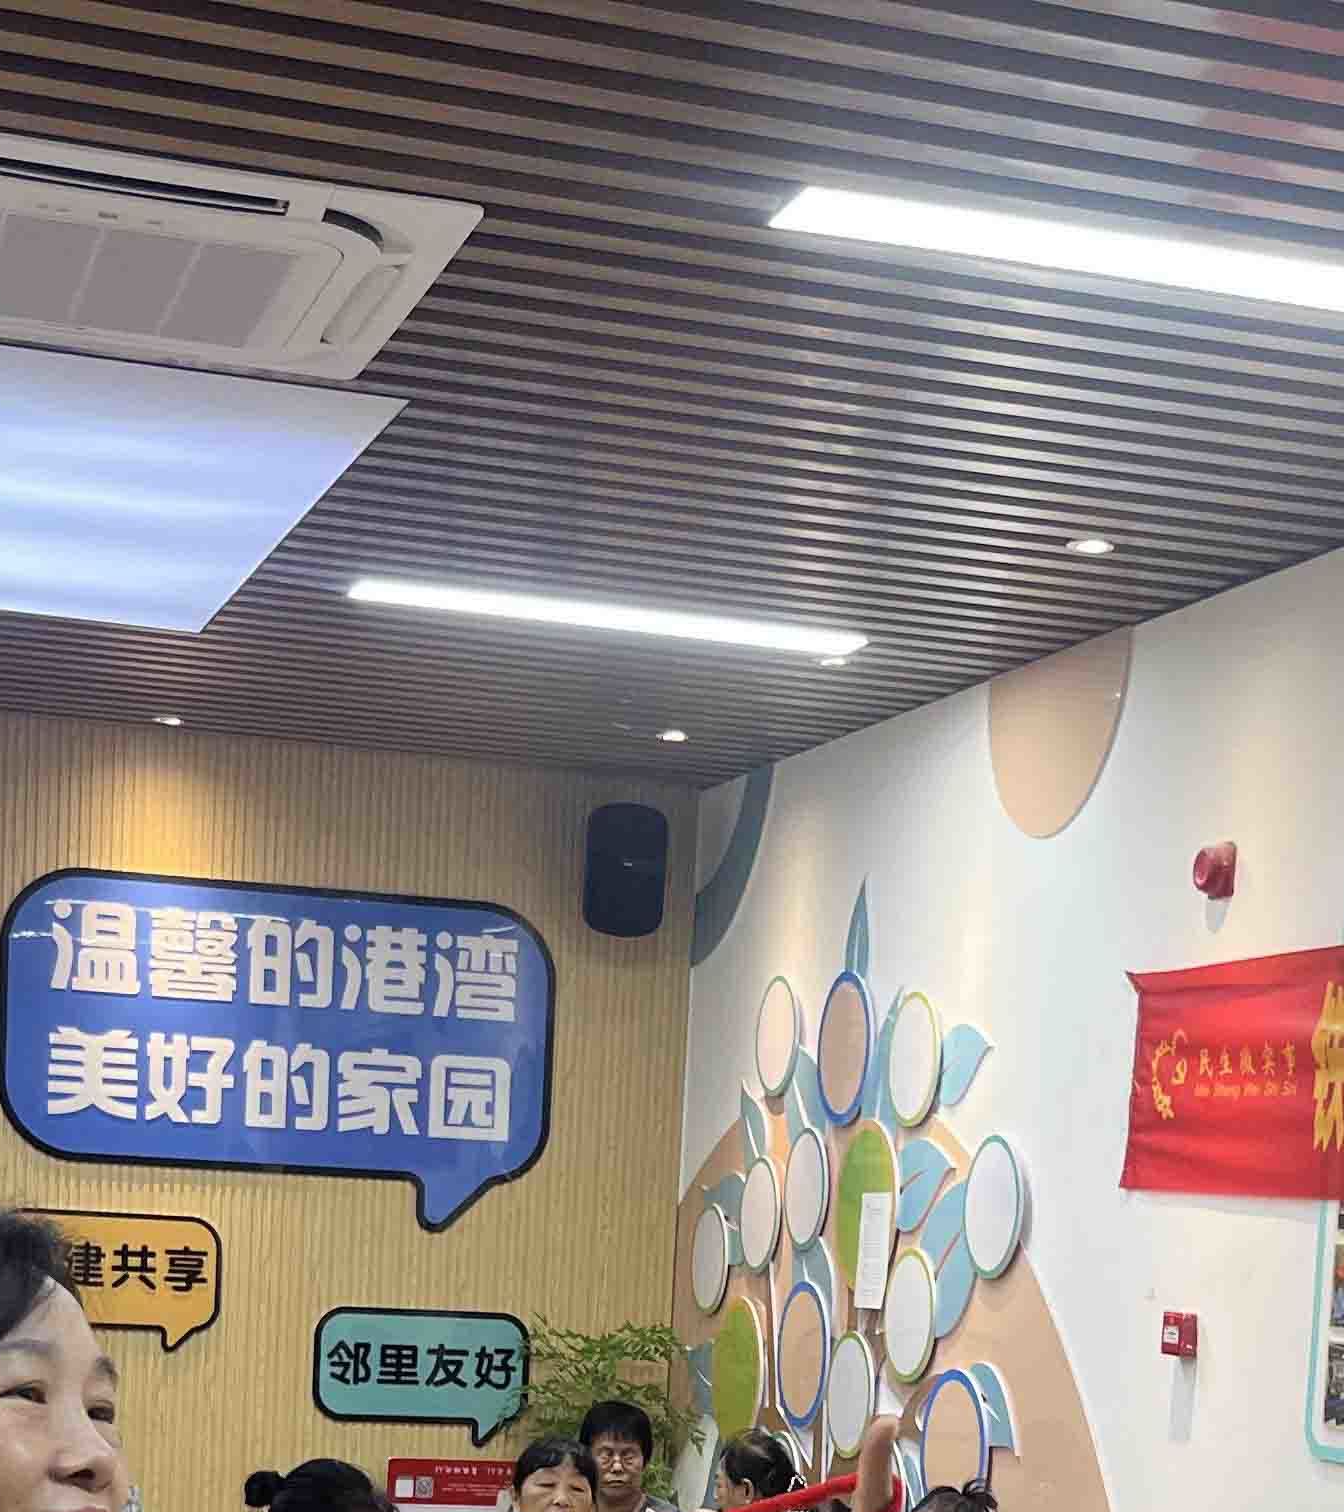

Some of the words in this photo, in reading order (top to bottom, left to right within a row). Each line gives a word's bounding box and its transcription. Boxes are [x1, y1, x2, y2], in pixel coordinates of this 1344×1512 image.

[48, 899, 520, 1023] 温馨的港湾
[46, 1025, 512, 1142] 美好的家园
[327, 1340, 517, 1390] 邻里友好
